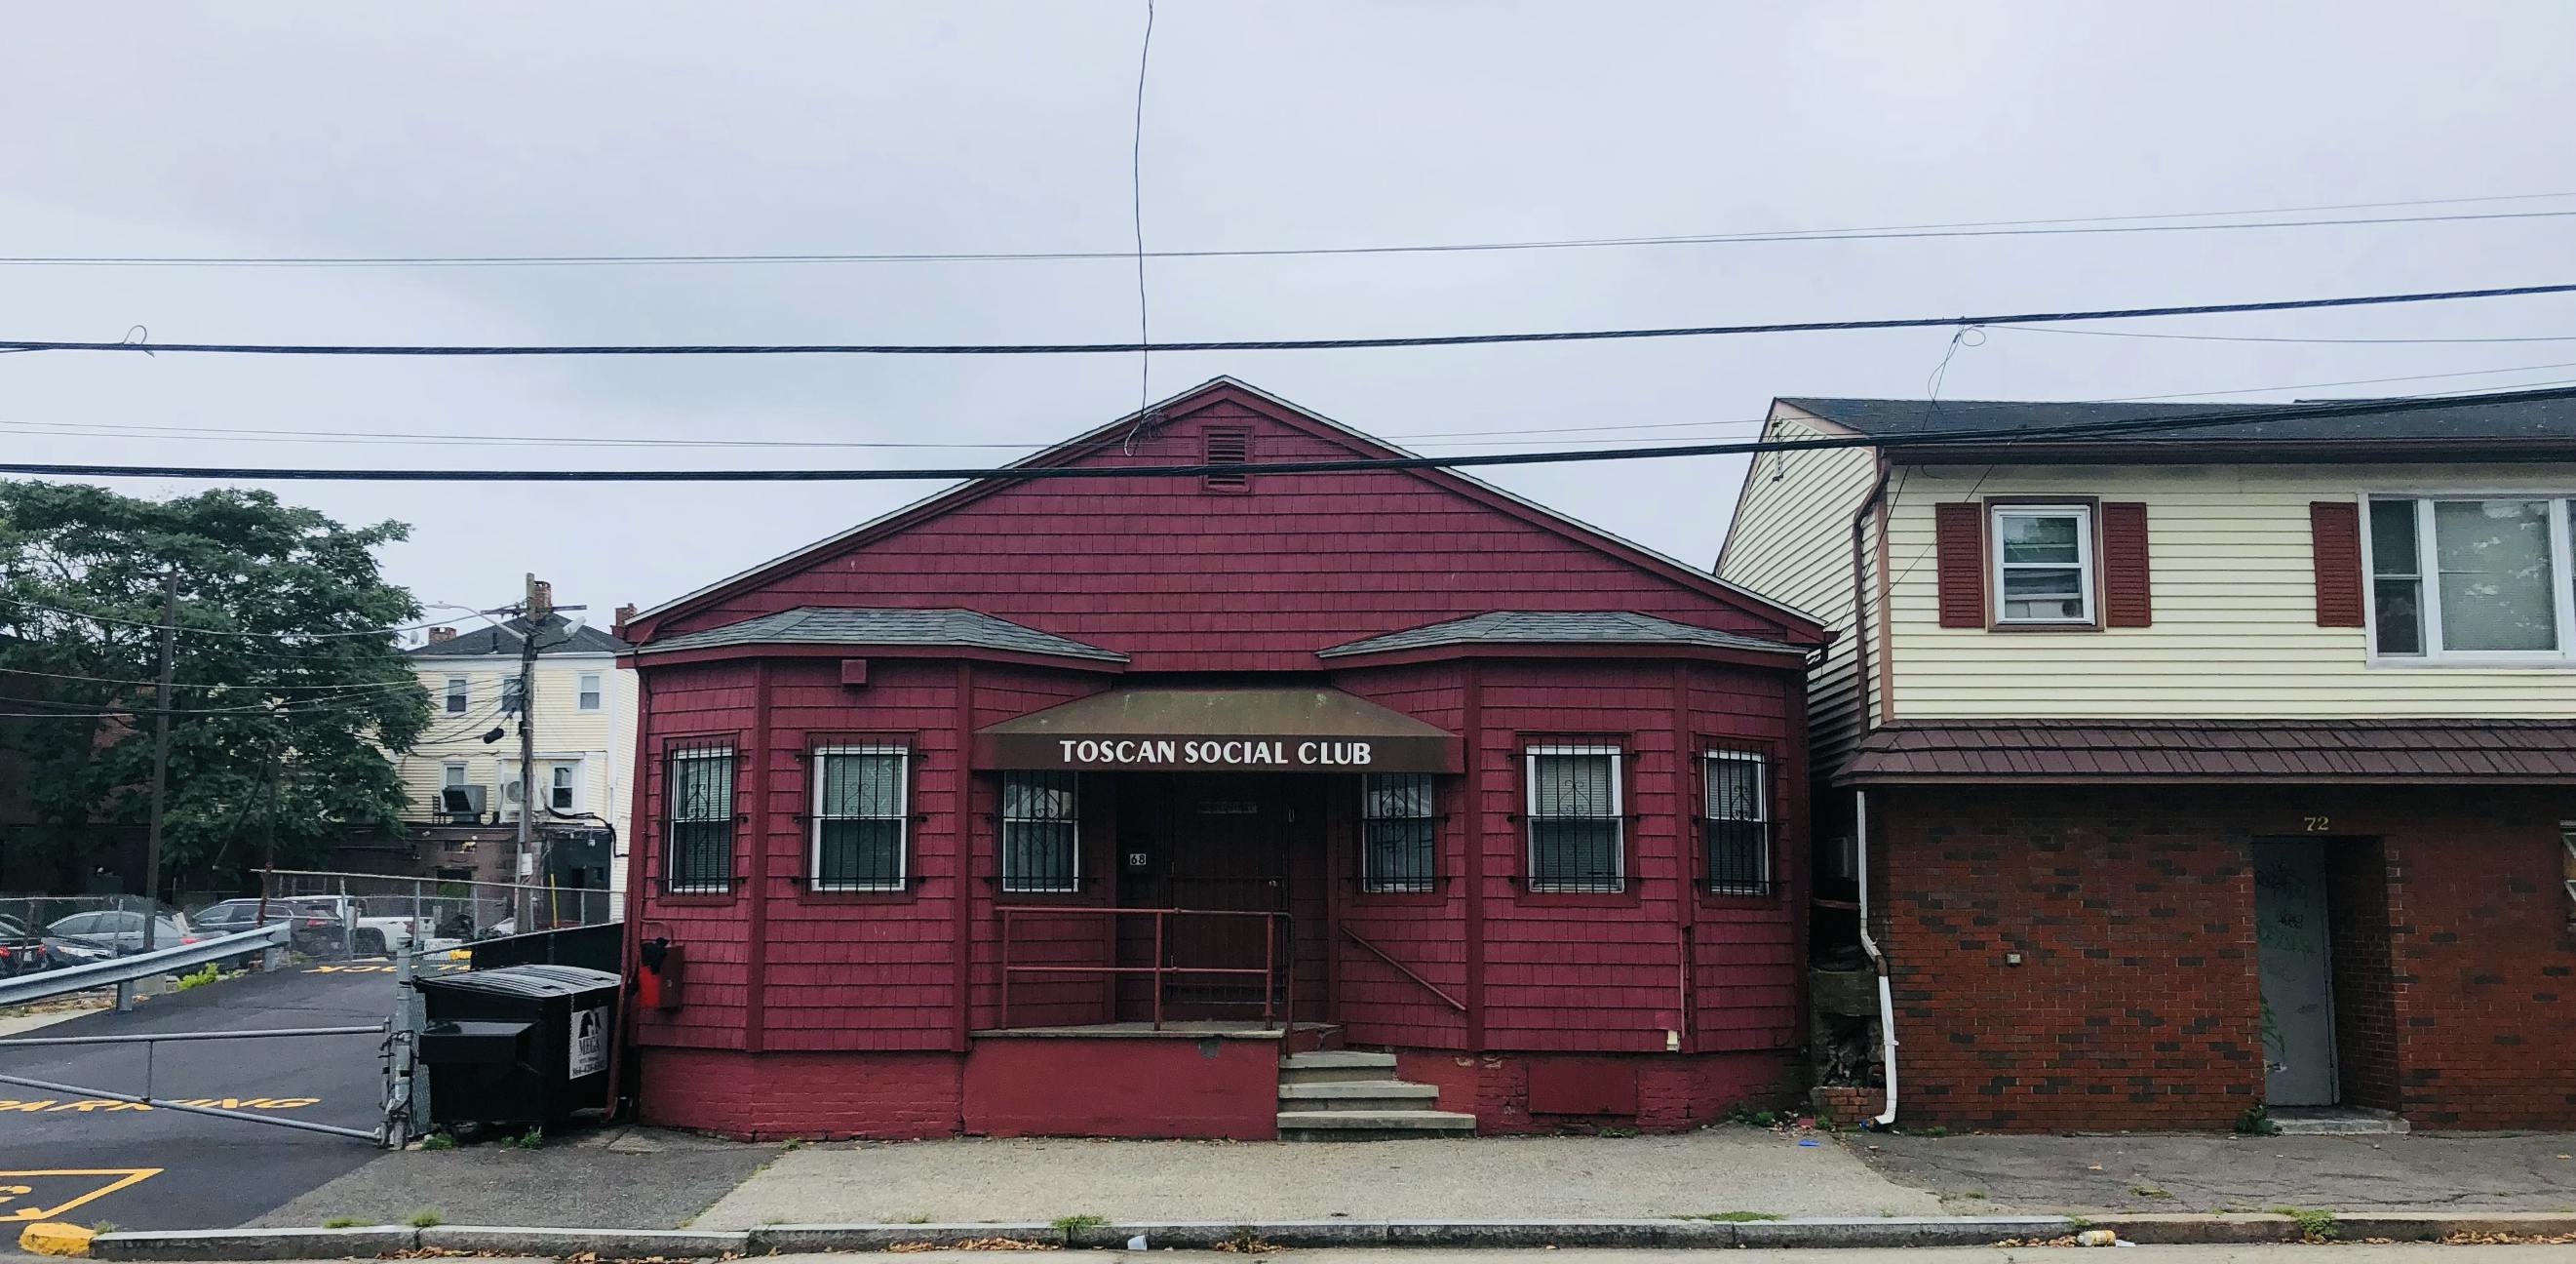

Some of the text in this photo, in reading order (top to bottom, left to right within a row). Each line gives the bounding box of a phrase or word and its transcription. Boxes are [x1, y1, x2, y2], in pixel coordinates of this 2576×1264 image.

[1060, 740, 1372, 765] TOSCAN SOCIAL CLUB
[2304, 816, 2329, 831] 72
[1131, 854, 1145, 865] 68
